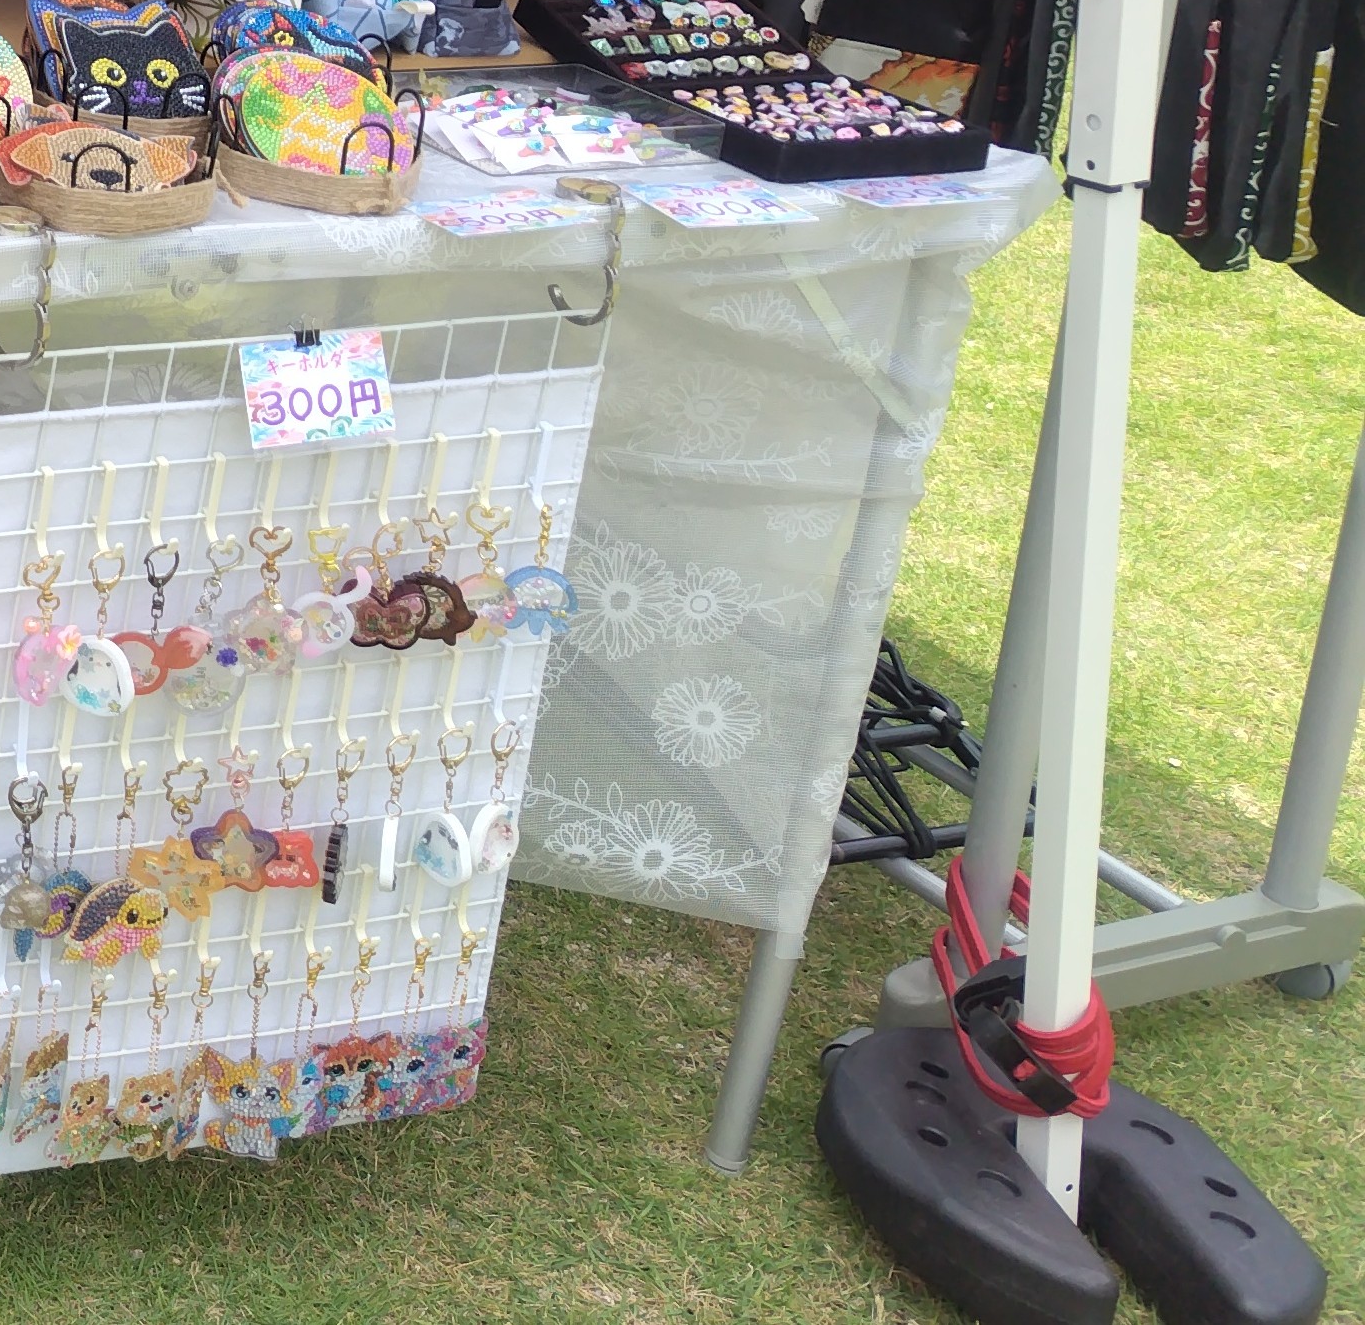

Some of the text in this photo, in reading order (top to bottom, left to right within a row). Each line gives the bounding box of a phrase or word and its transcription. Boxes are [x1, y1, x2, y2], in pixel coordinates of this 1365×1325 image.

[458, 208, 564, 226] 500円
[267, 350, 362, 375] キーホルダー
[260, 378, 381, 425] 300円
